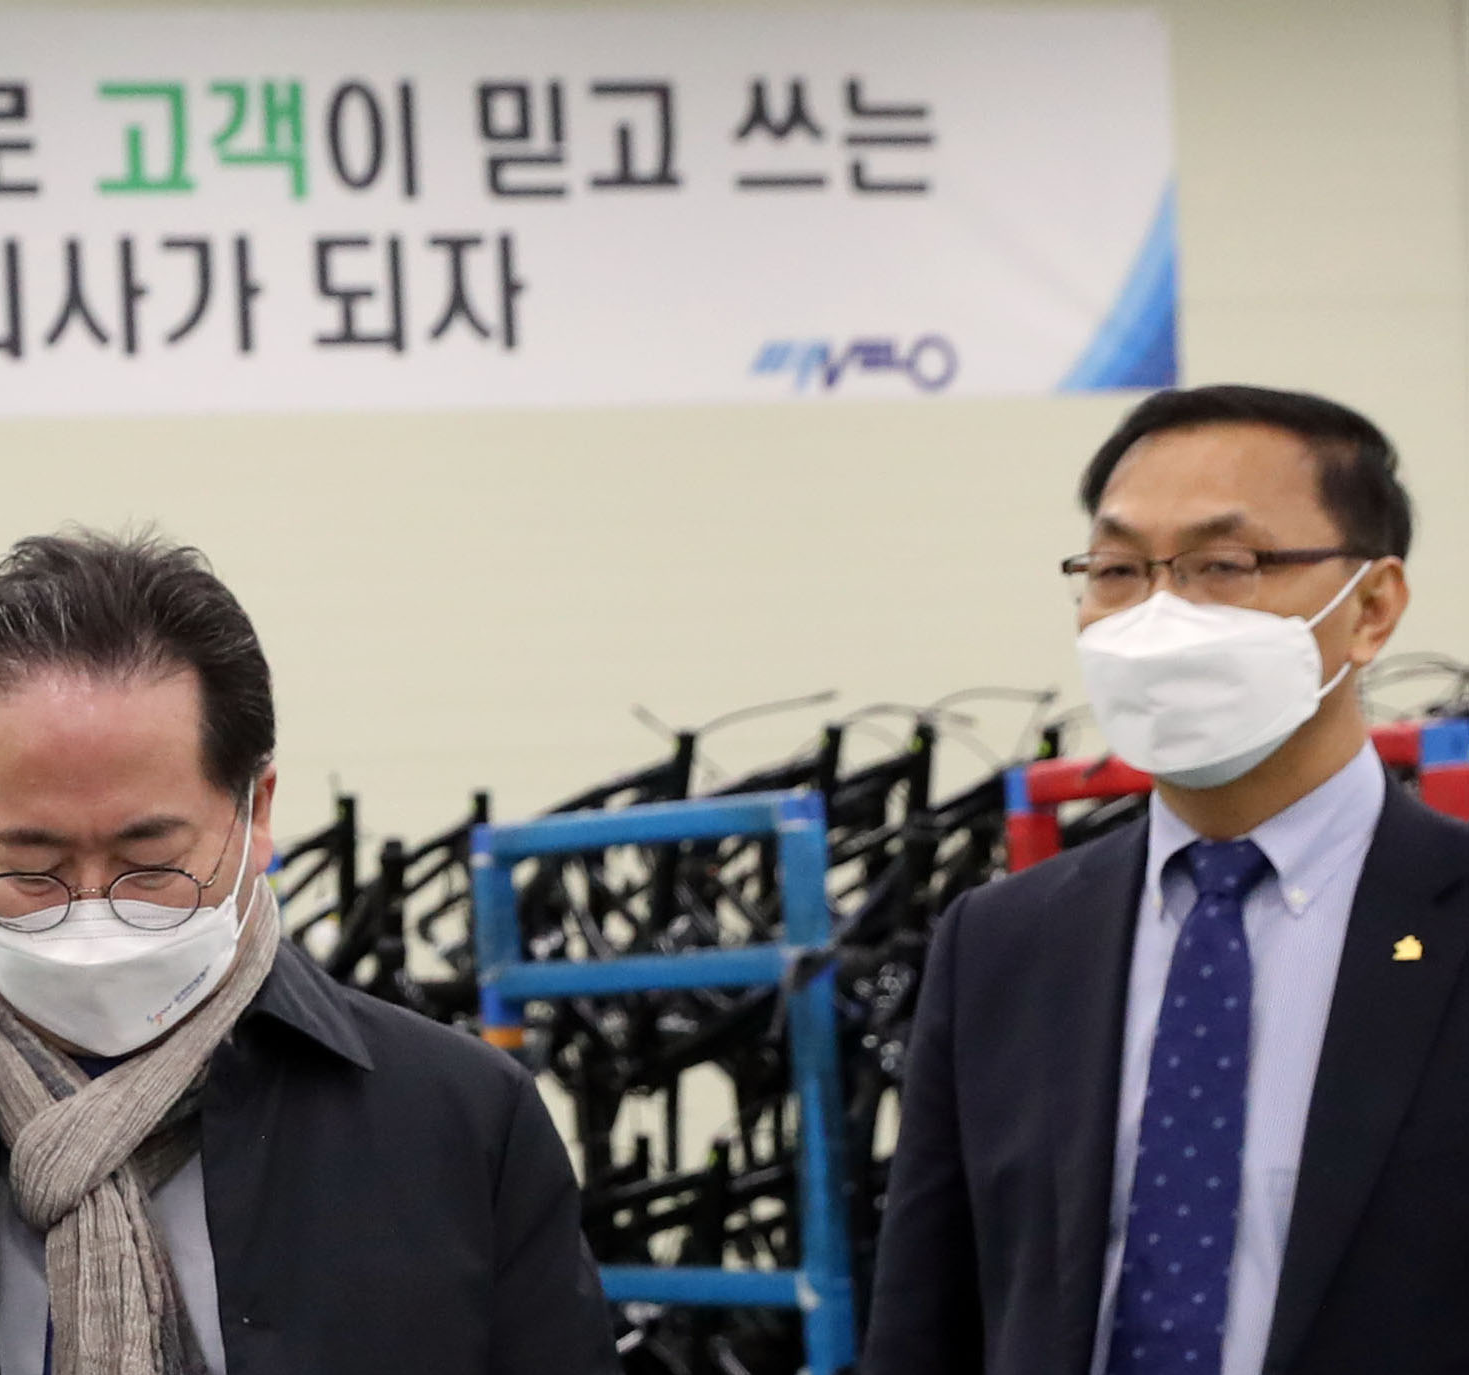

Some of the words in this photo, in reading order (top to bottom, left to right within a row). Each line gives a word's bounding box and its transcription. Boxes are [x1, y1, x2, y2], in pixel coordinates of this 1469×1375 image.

[94, 78, 418, 199] 고객이
[475, 79, 681, 199] 믿고
[736, 77, 935, 195] 쓰는
[314, 232, 525, 352] 되자
